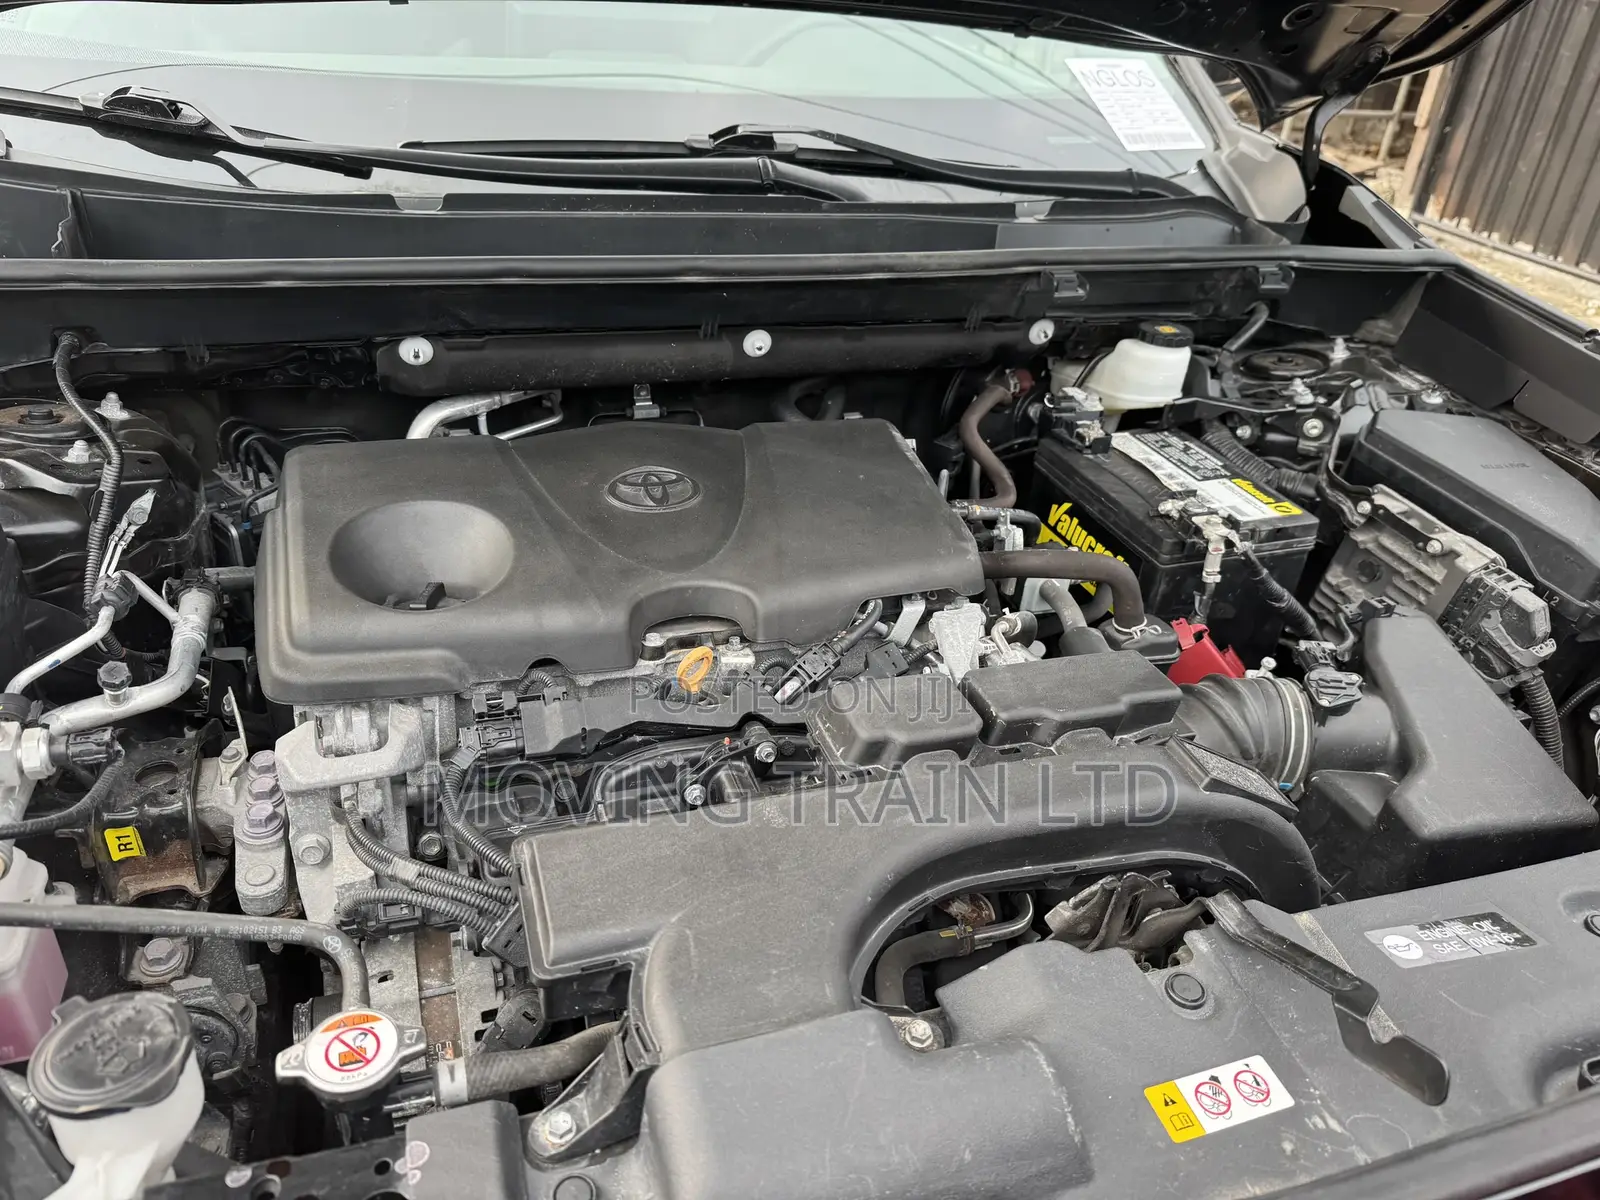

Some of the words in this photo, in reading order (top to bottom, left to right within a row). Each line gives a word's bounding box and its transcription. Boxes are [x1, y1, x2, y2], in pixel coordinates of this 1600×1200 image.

[1047, 503, 1129, 567] Valucr
[115, 834, 135, 853] R1
[1433, 941, 1467, 954] SAE
